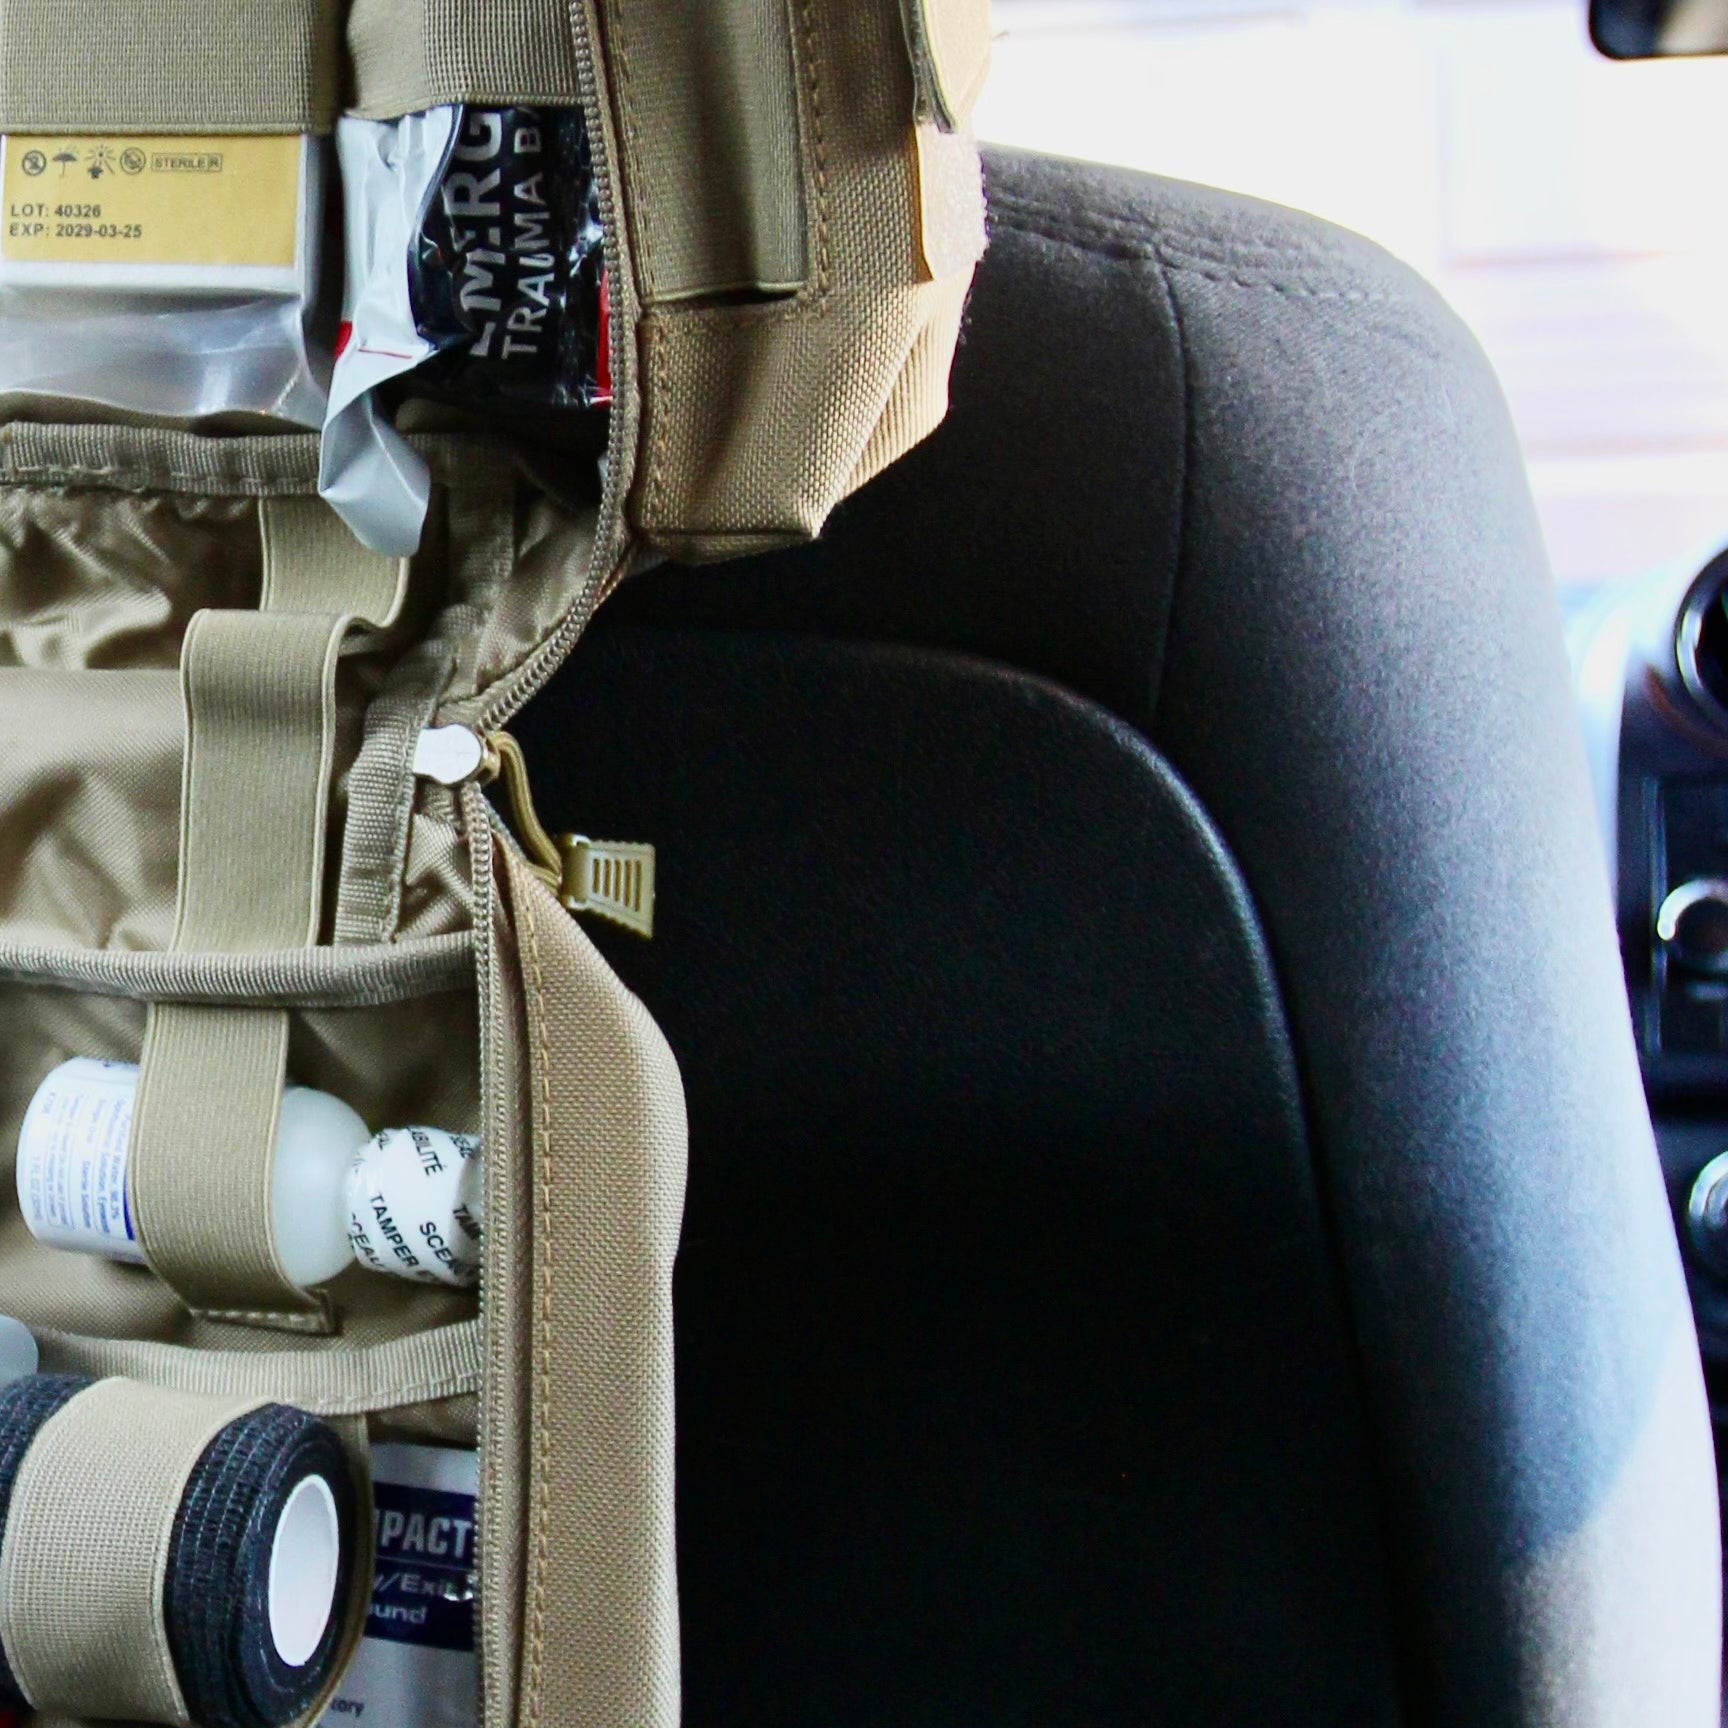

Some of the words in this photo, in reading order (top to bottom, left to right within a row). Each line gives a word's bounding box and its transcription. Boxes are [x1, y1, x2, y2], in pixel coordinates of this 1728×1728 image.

[154, 156, 206, 170] STERILE
[11, 204, 49, 218] LOT:
[54, 204, 102, 218] 40326
[9, 223, 49, 238] EXP:
[55, 223, 142, 239] 2029-03-25
[370, 1194, 419, 1268] TAMPER
